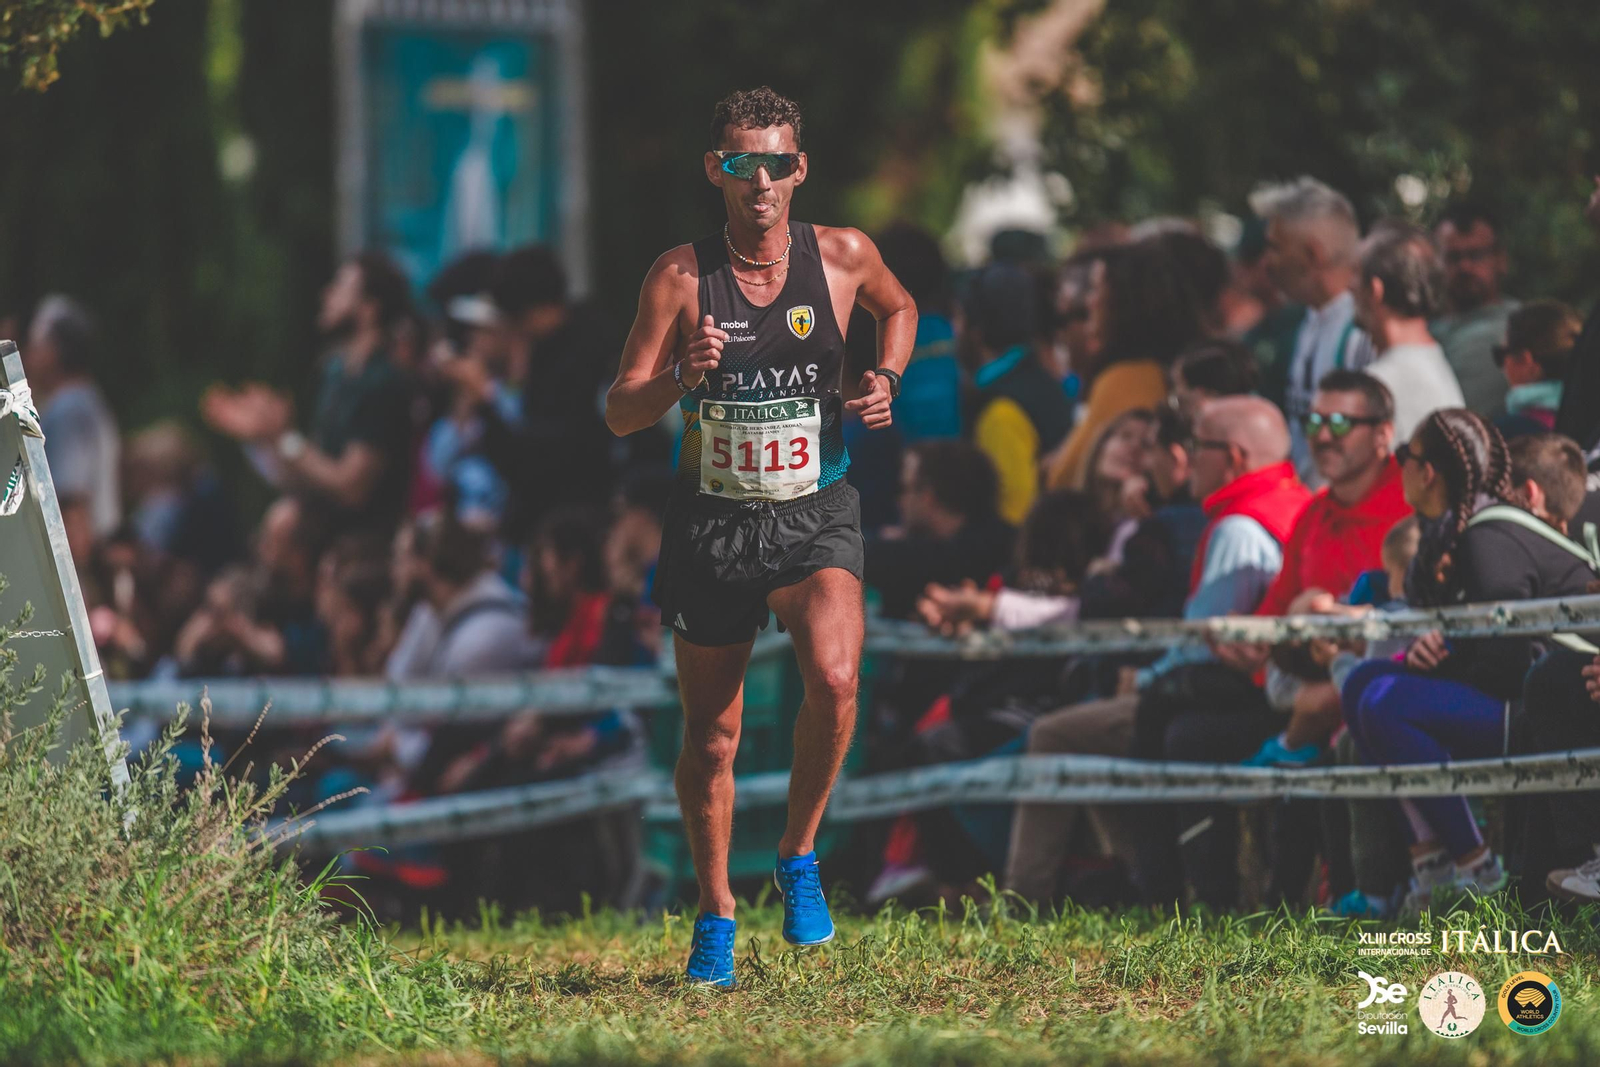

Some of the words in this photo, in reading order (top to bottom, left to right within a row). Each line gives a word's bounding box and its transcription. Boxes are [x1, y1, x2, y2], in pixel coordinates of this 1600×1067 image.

[721, 320, 748, 328] mobel
[722, 364, 818, 390] PLAYAS
[734, 406, 789, 419] ITÁLICA
[712, 436, 810, 472] 5113
